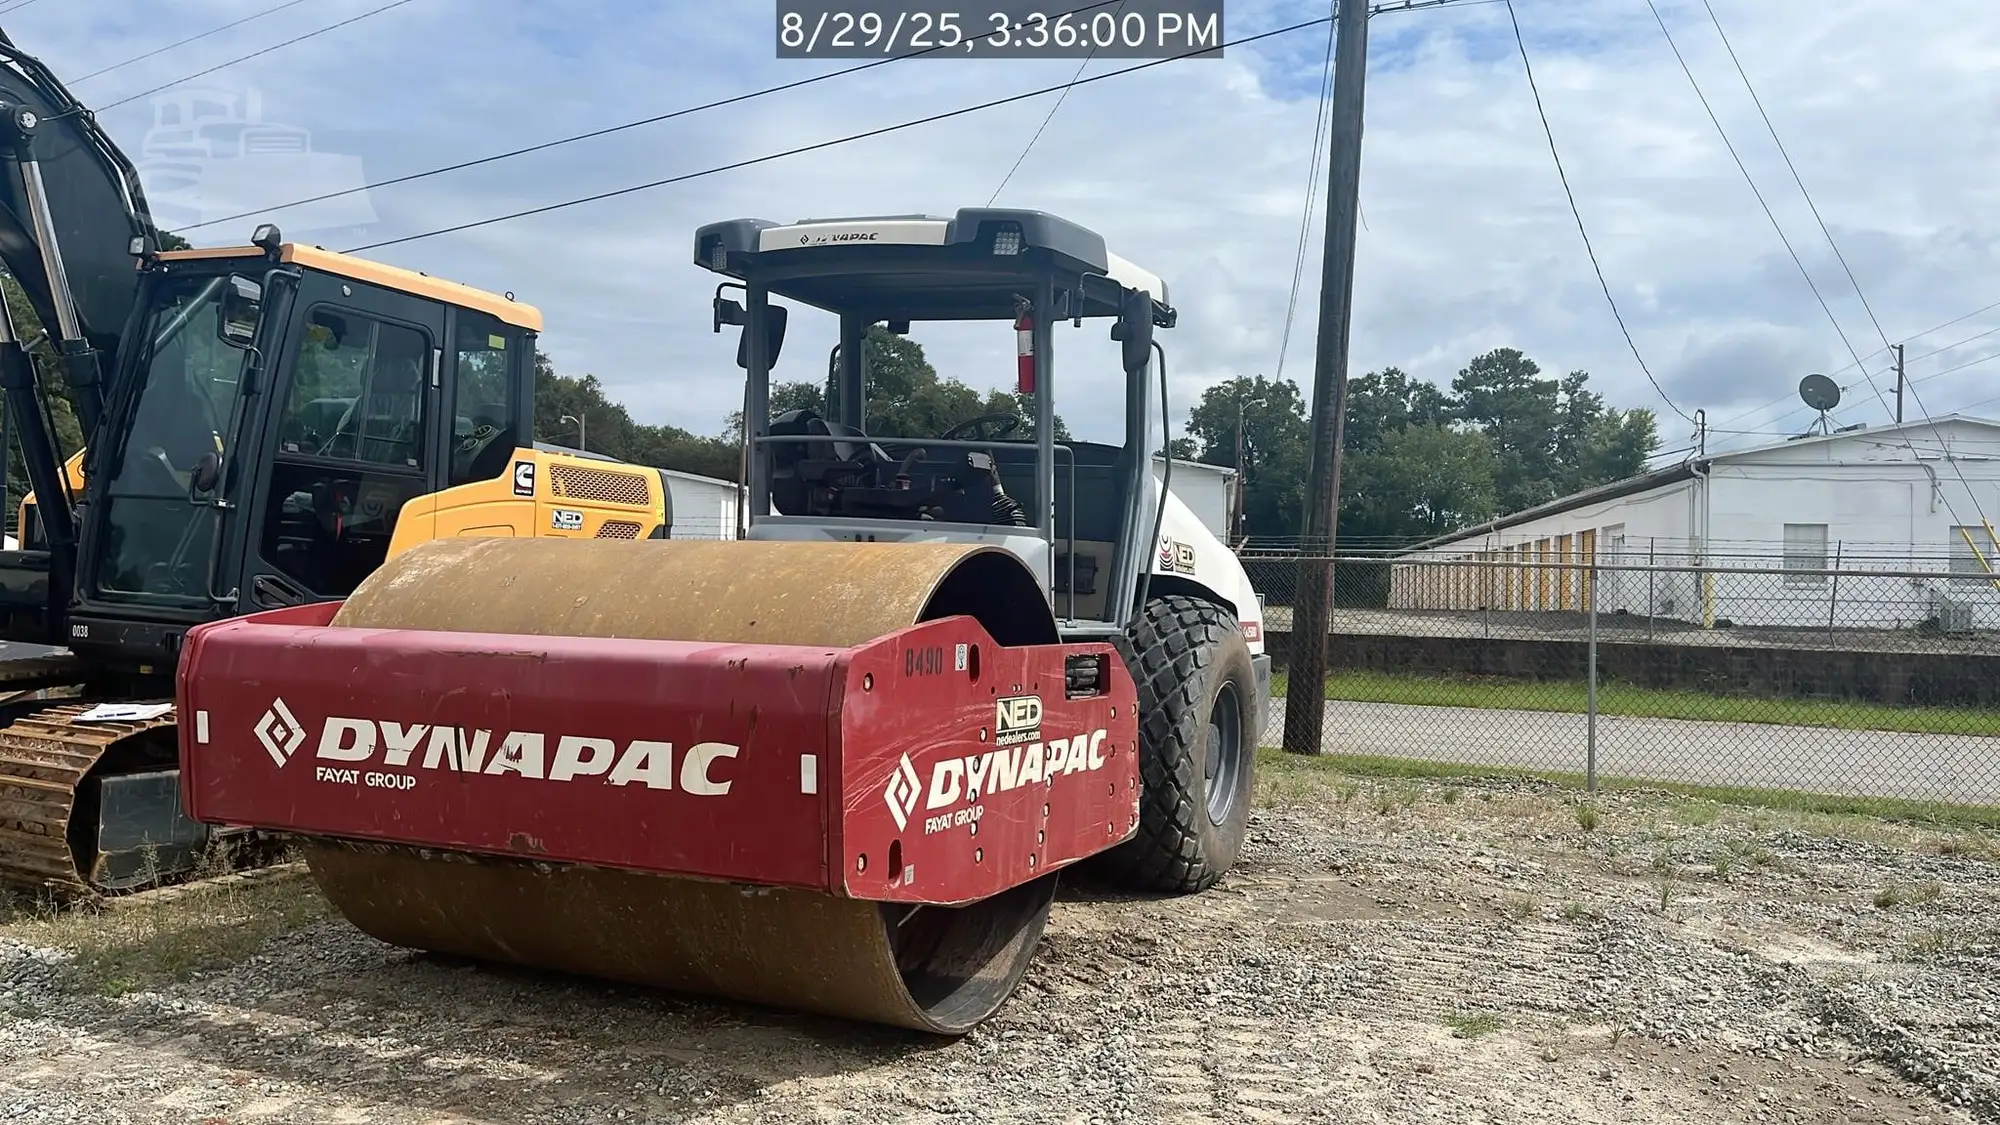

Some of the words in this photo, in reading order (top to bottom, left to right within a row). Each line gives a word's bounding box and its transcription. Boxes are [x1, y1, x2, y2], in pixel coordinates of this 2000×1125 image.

[553, 510, 584, 524] NED
[1174, 544, 1195, 564] NED
[72, 624, 89, 638] 0038
[905, 647, 943, 678] 8490
[997, 697, 1042, 730] NED
[996, 730, 1041, 746] nedealers.com
[316, 715, 740, 797] DYNAPAC
[925, 728, 1108, 810] DYNAPAC
[316, 766, 359, 786] FAYAT
[364, 770, 416, 790] GROUP
[924, 814, 953, 835] FAYAT
[954, 804, 984, 826] GROUP
